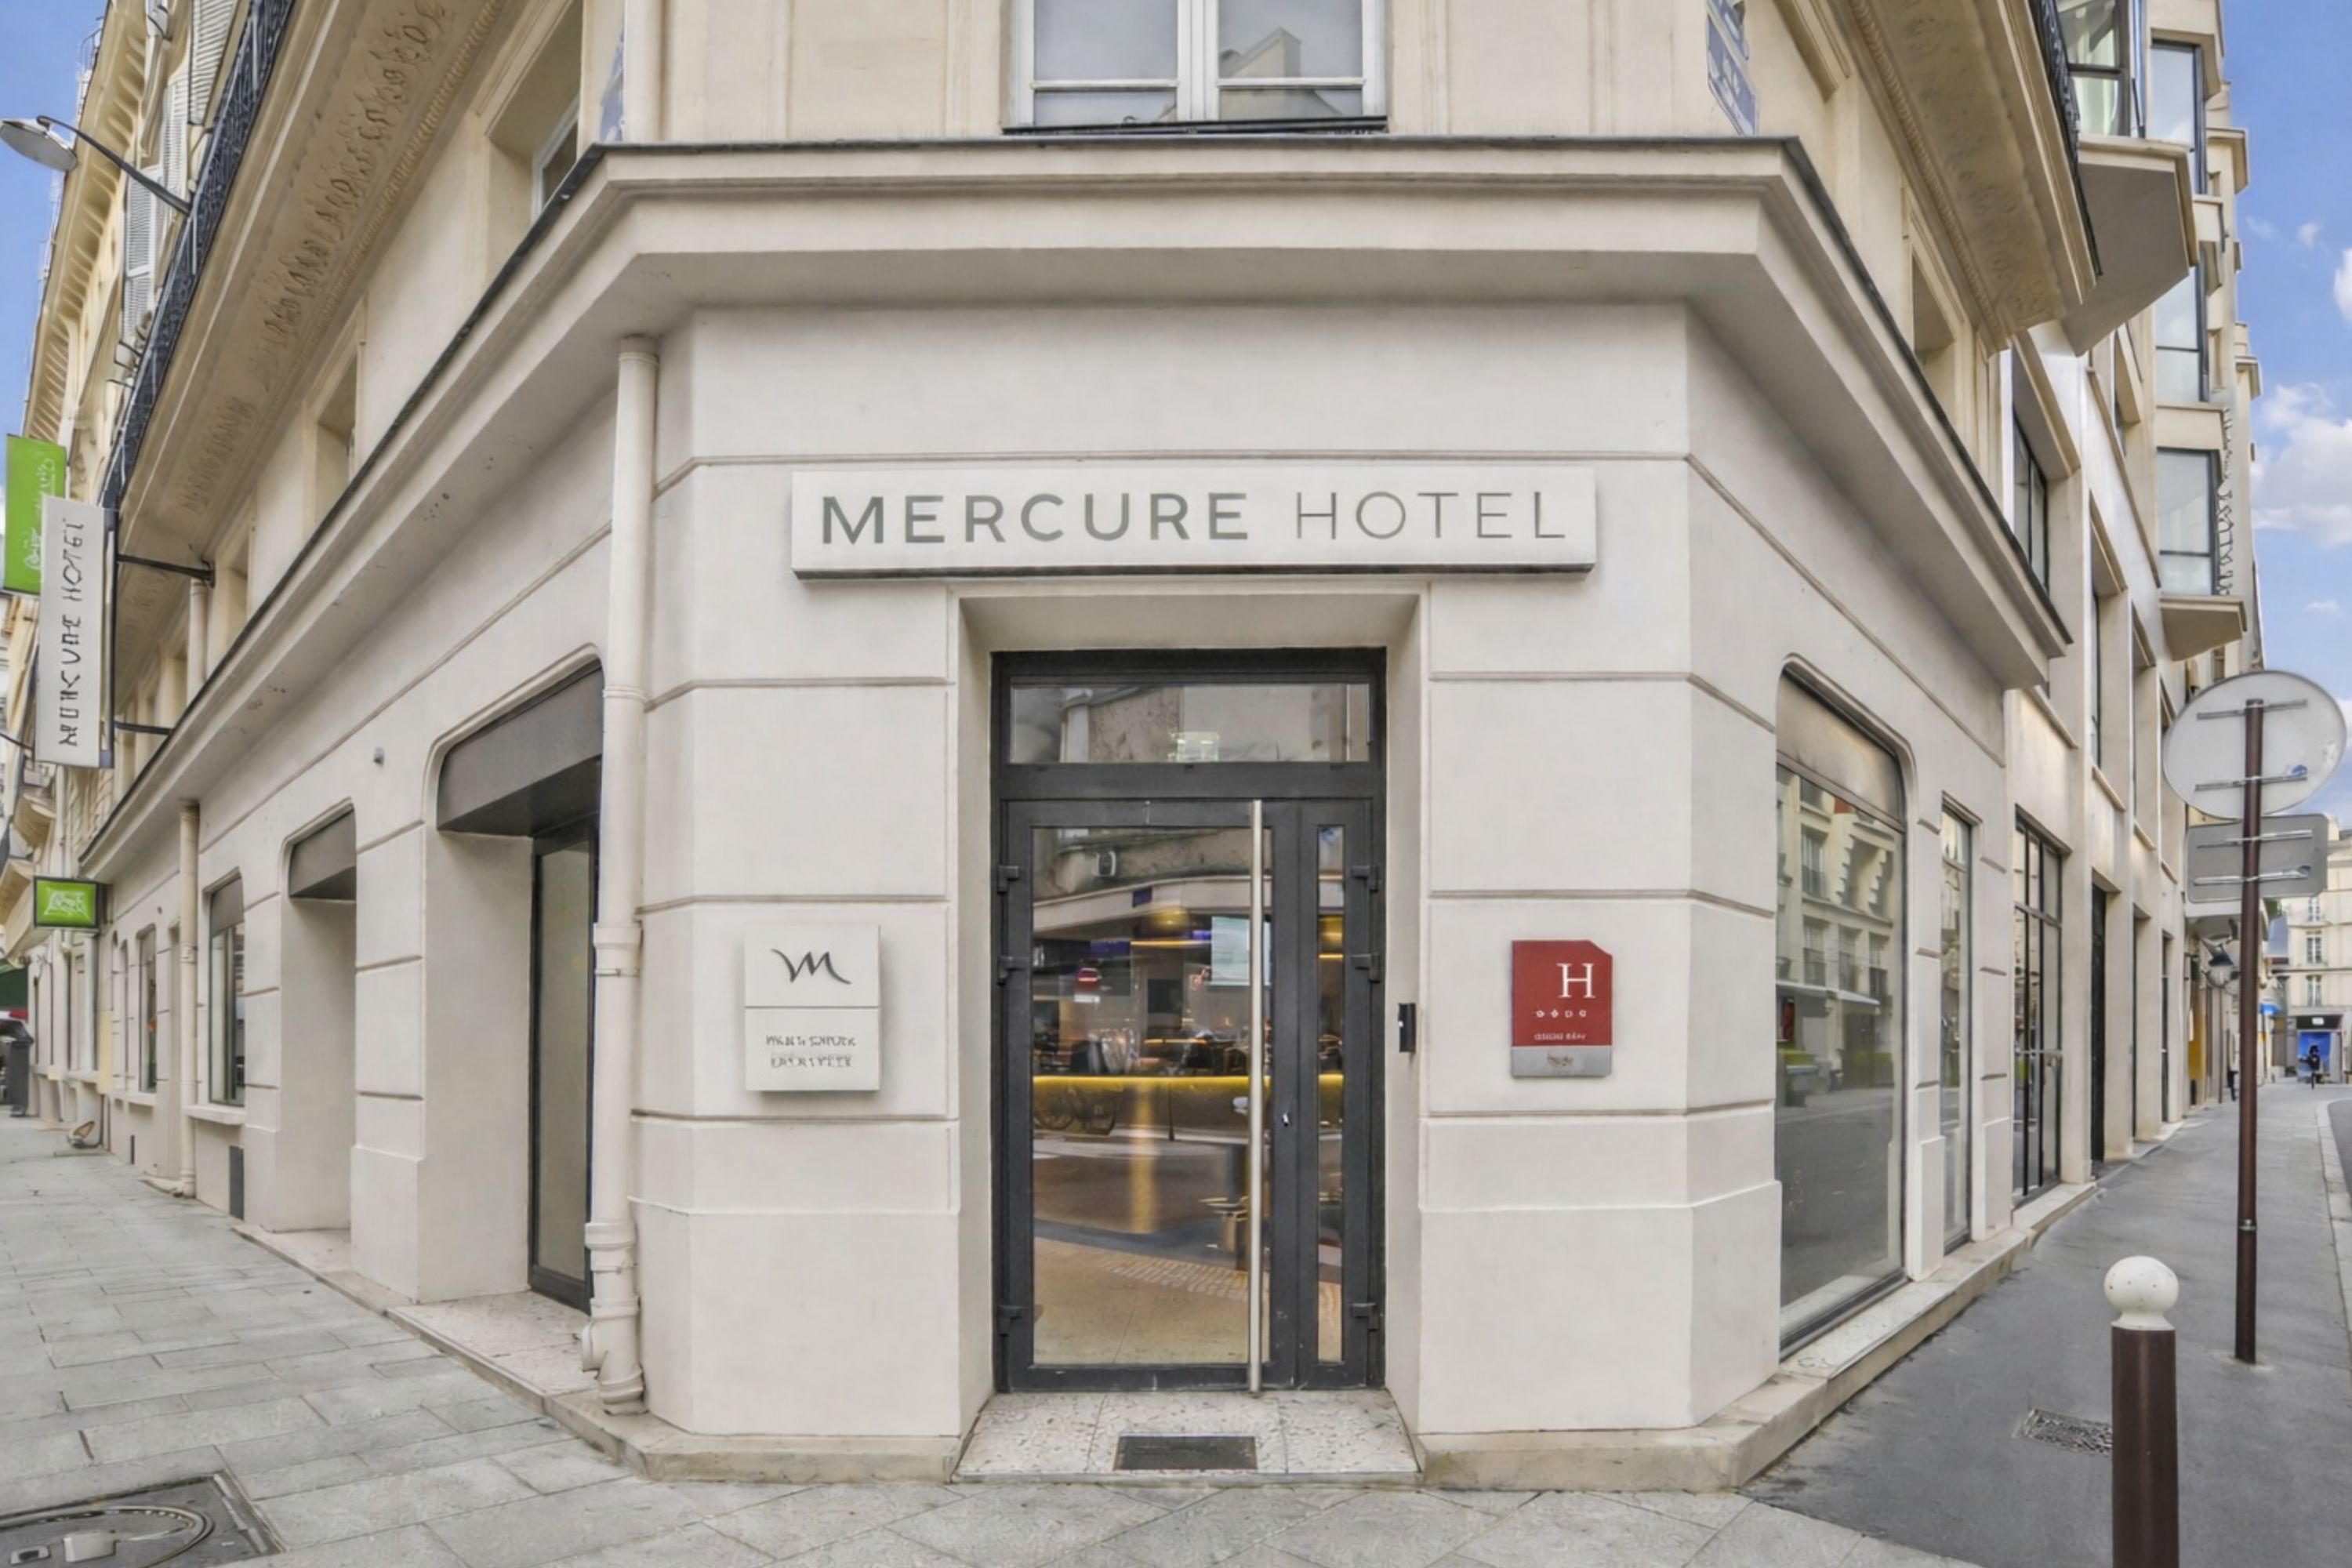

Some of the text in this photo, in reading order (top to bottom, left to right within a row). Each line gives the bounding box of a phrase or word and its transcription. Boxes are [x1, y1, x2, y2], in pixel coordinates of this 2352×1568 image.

[822, 490, 1566, 545] MERCURE HOTEL
[1556, 963, 1596, 999] H
